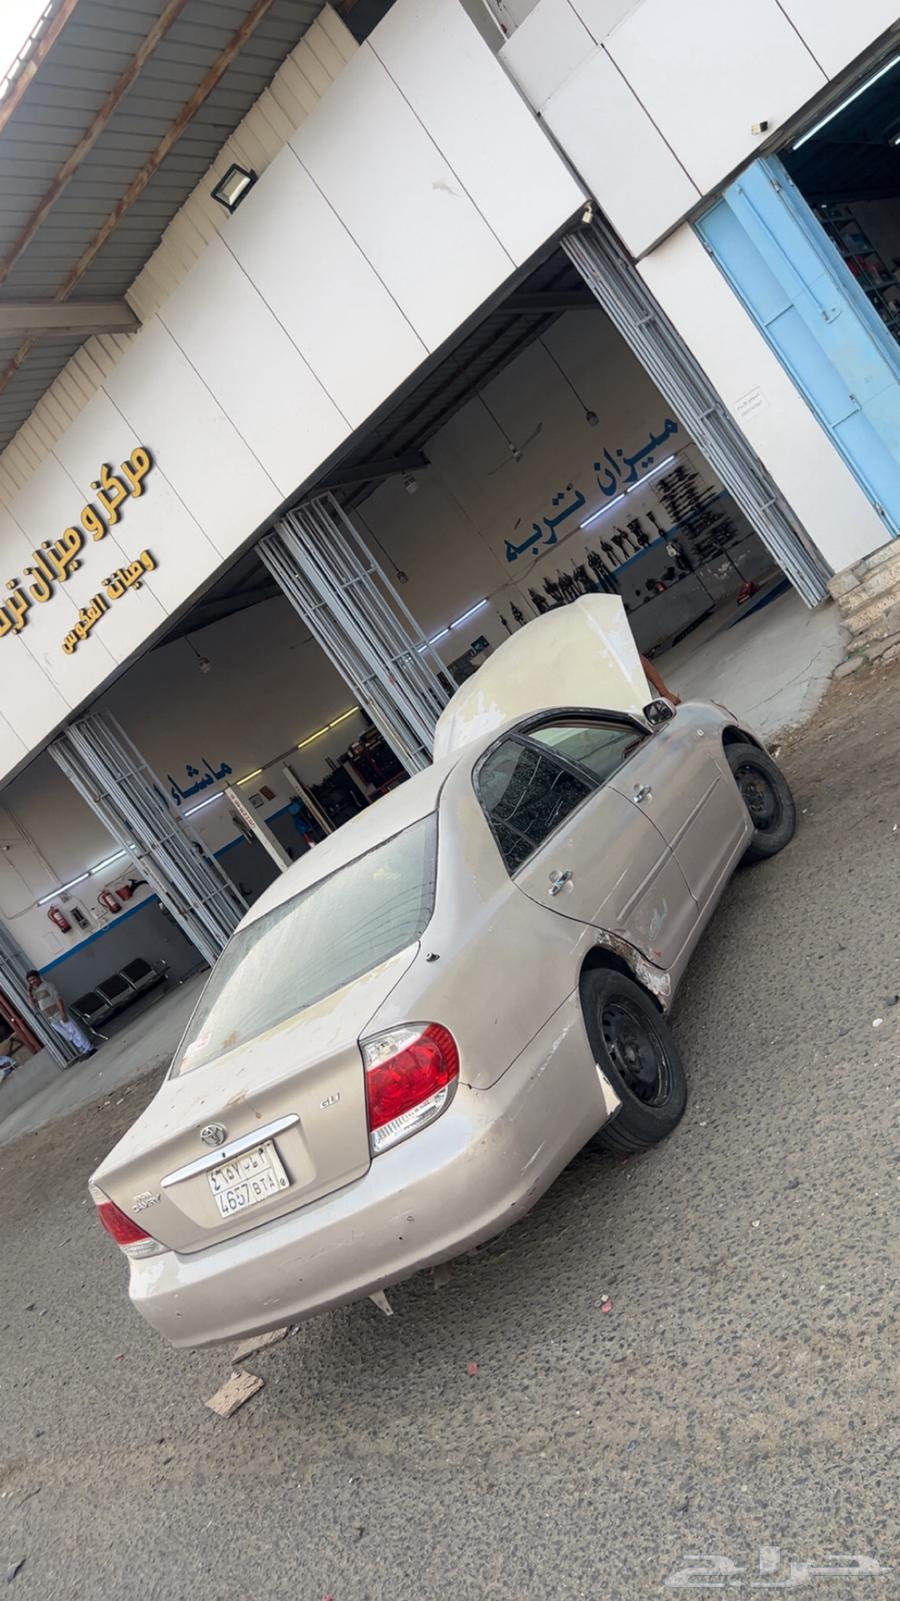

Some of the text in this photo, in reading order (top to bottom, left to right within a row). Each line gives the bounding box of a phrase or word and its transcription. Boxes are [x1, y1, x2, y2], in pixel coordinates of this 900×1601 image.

[594, 418, 678, 496] ميزان
[0, 446, 153, 637] مركز و ميزان ترب
[62, 549, 158, 655] وصيانة العكوس
[218, 1182, 252, 1214] 4657
